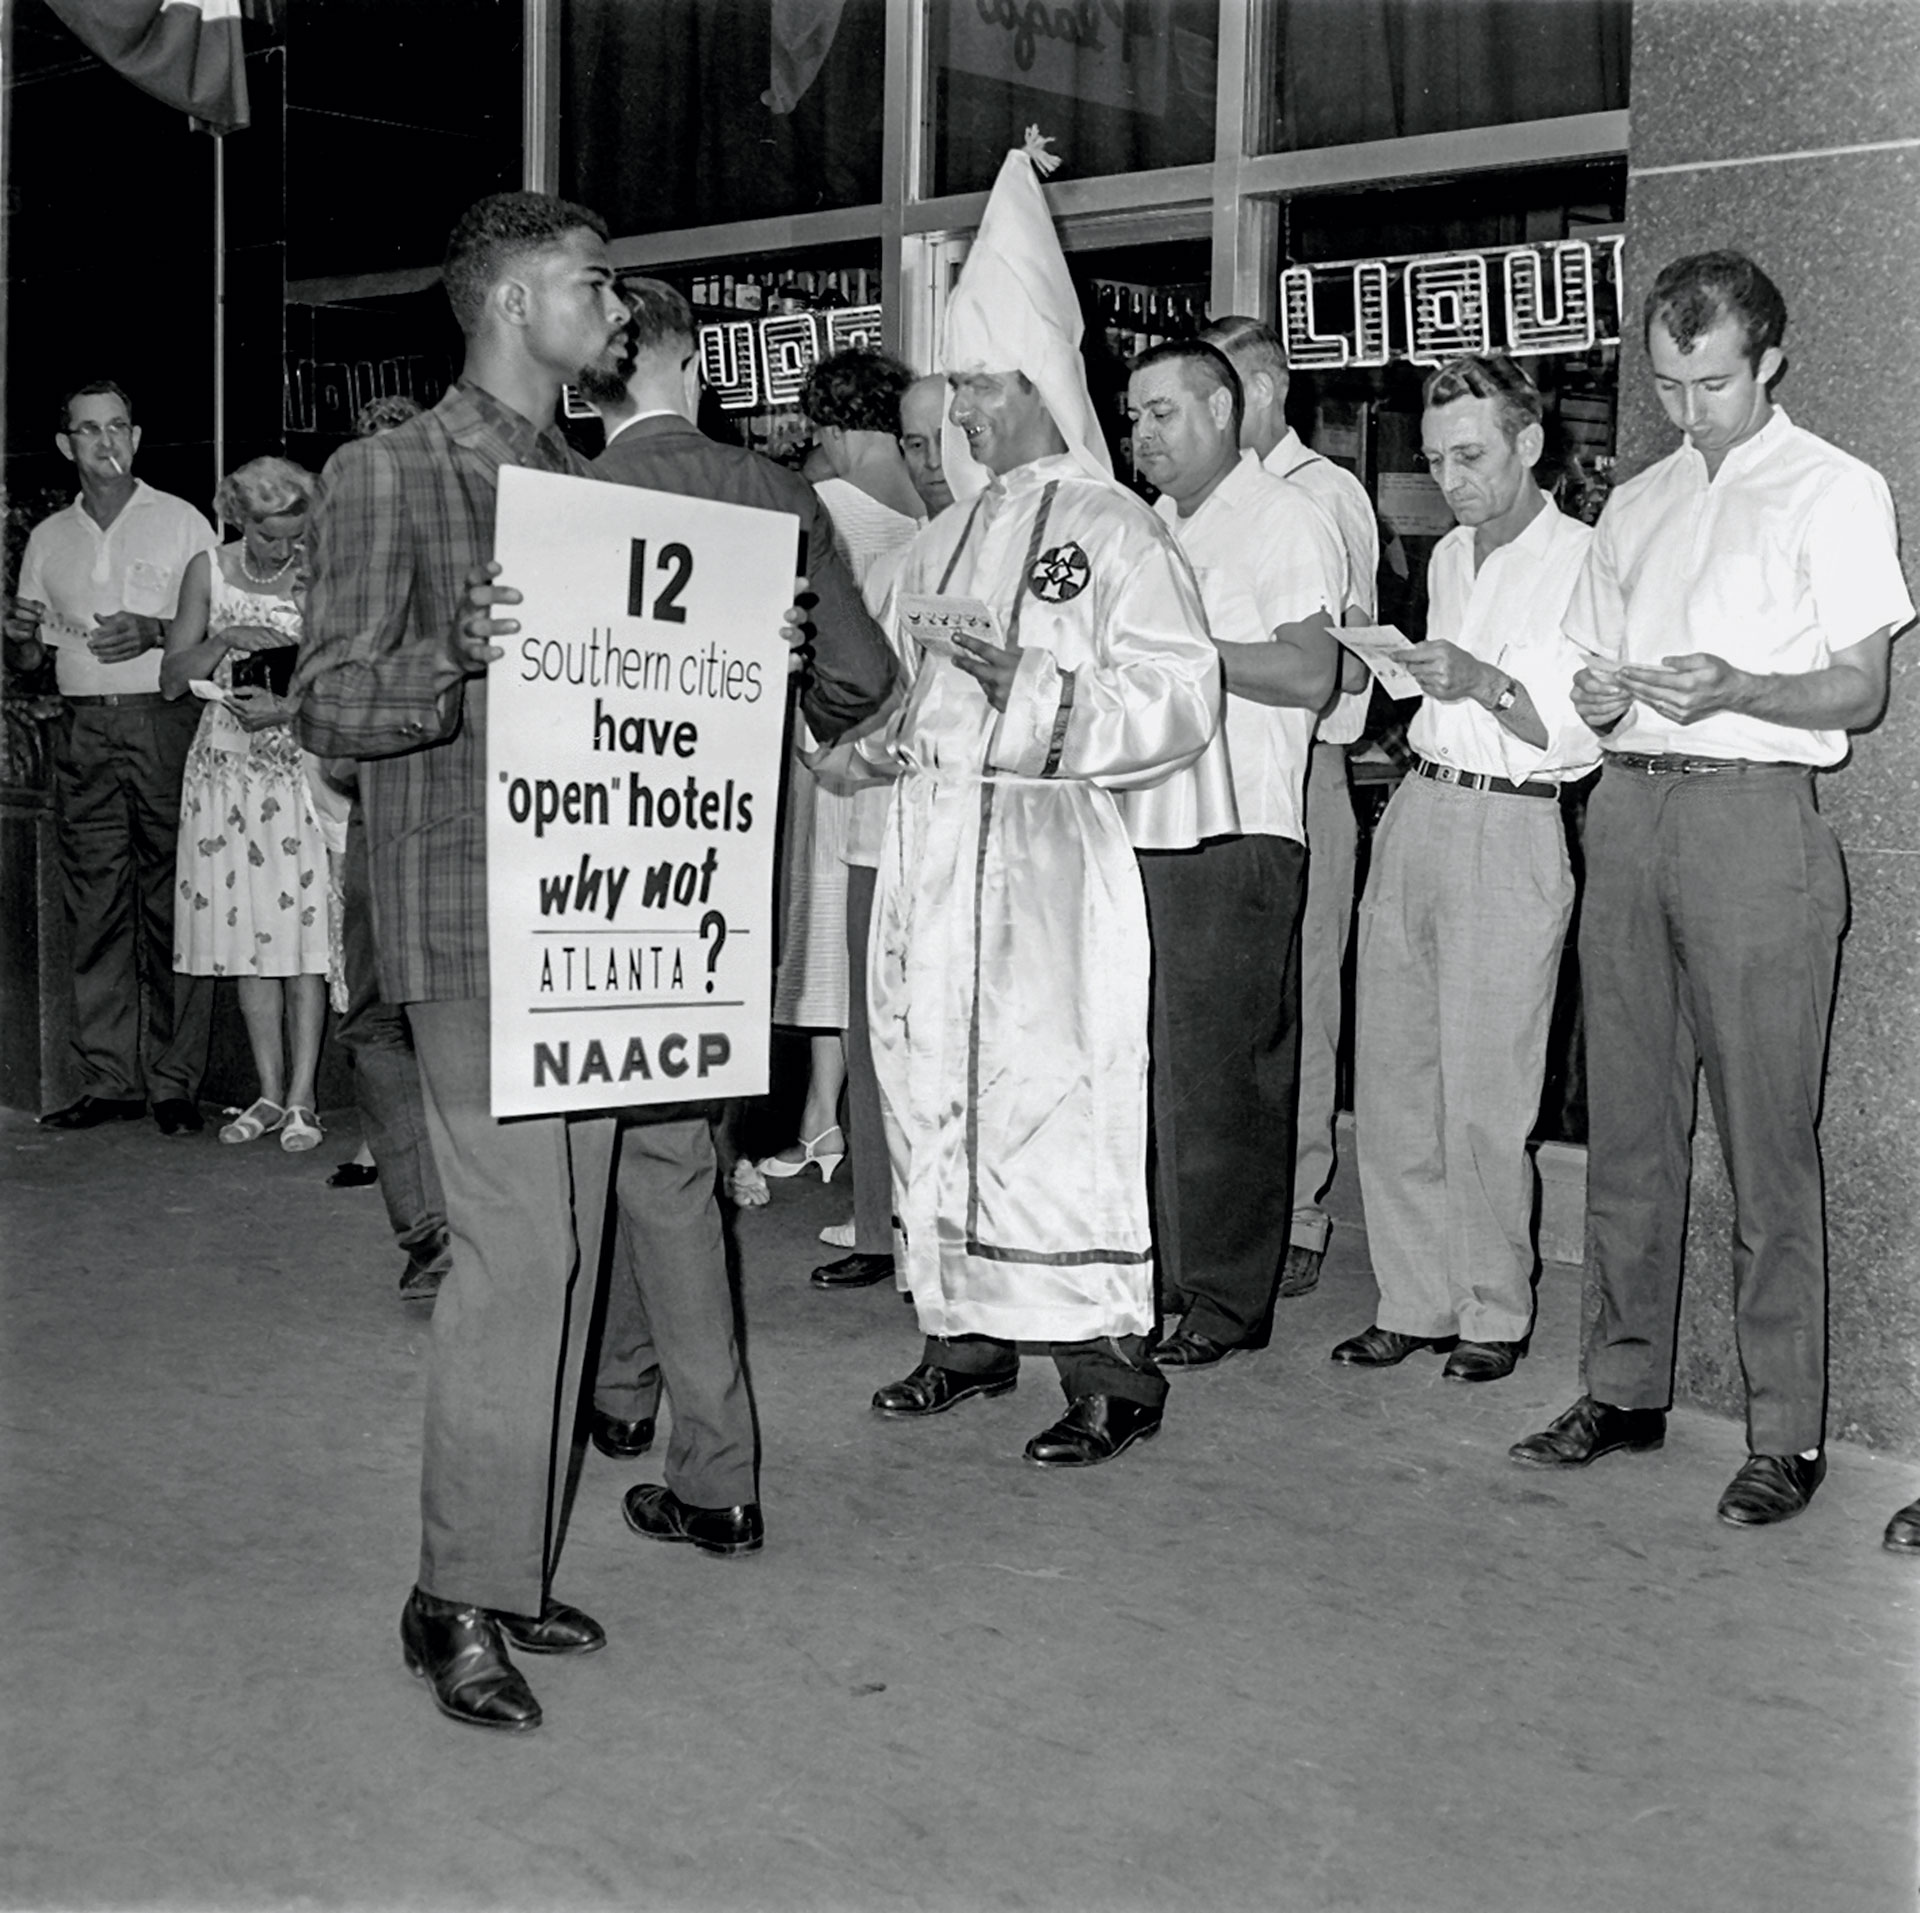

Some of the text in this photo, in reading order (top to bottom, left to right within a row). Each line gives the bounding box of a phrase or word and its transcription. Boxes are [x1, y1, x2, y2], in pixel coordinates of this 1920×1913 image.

[1280, 236, 1624, 370] LIQU
[628, 537, 693, 624] 12
[520, 627, 762, 703] southern cities
[594, 698, 698, 758] have
[628, 771, 753, 833] hotels
[540, 847, 719, 921] why not
[533, 1032, 731, 1087] NAACP
